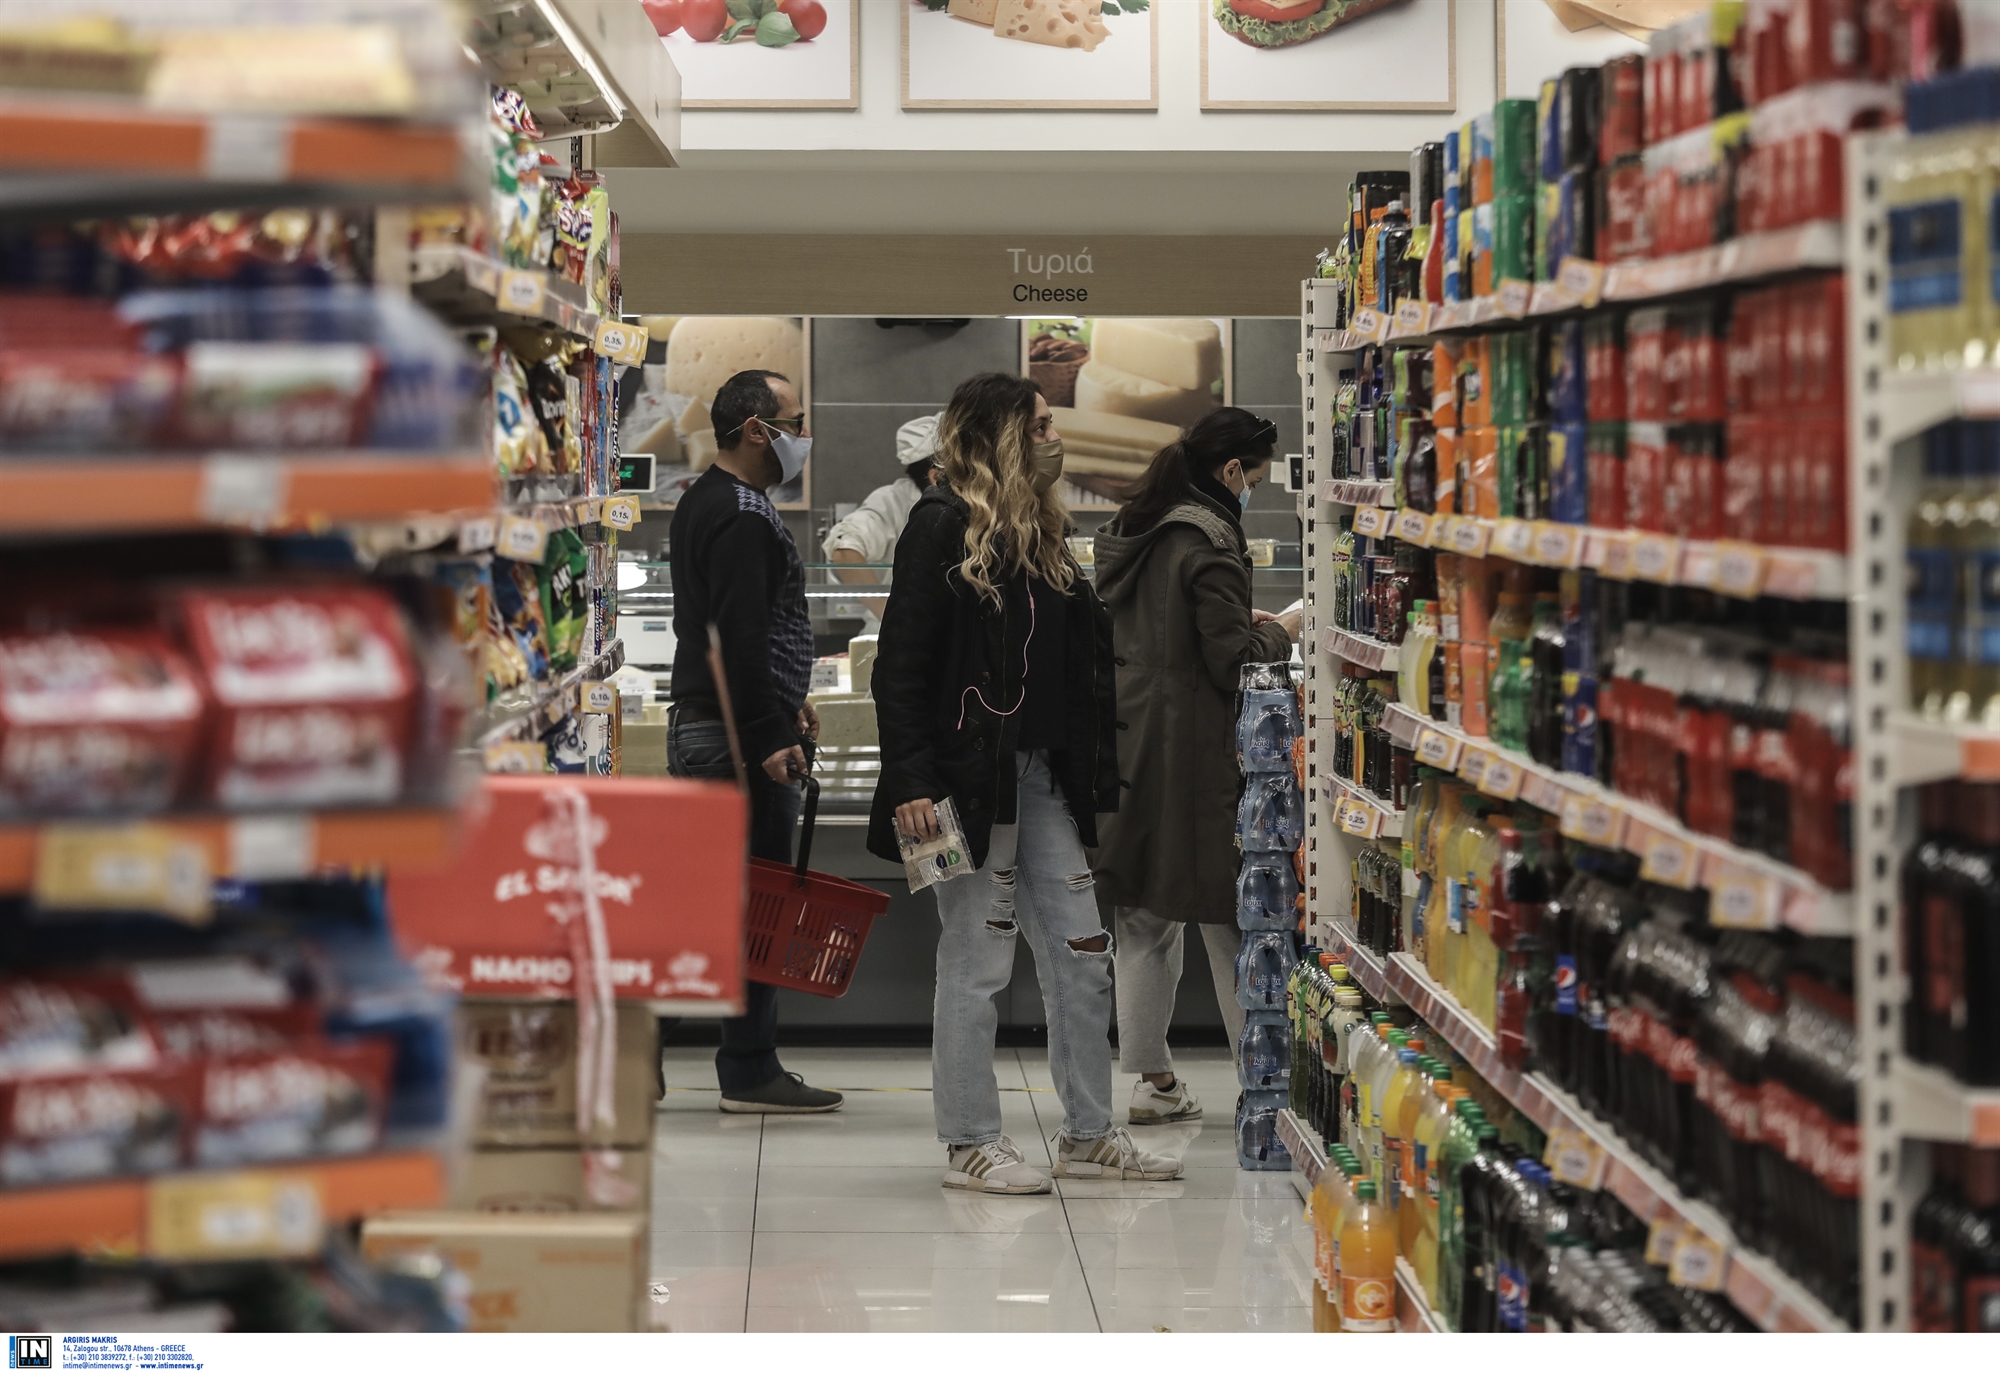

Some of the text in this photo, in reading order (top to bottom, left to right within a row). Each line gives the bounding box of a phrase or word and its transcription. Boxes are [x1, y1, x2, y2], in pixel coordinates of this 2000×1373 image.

[1006, 247, 1094, 280] Τυριά
[1013, 284, 1088, 302] Cheese
[471, 956, 572, 985] NACHO
